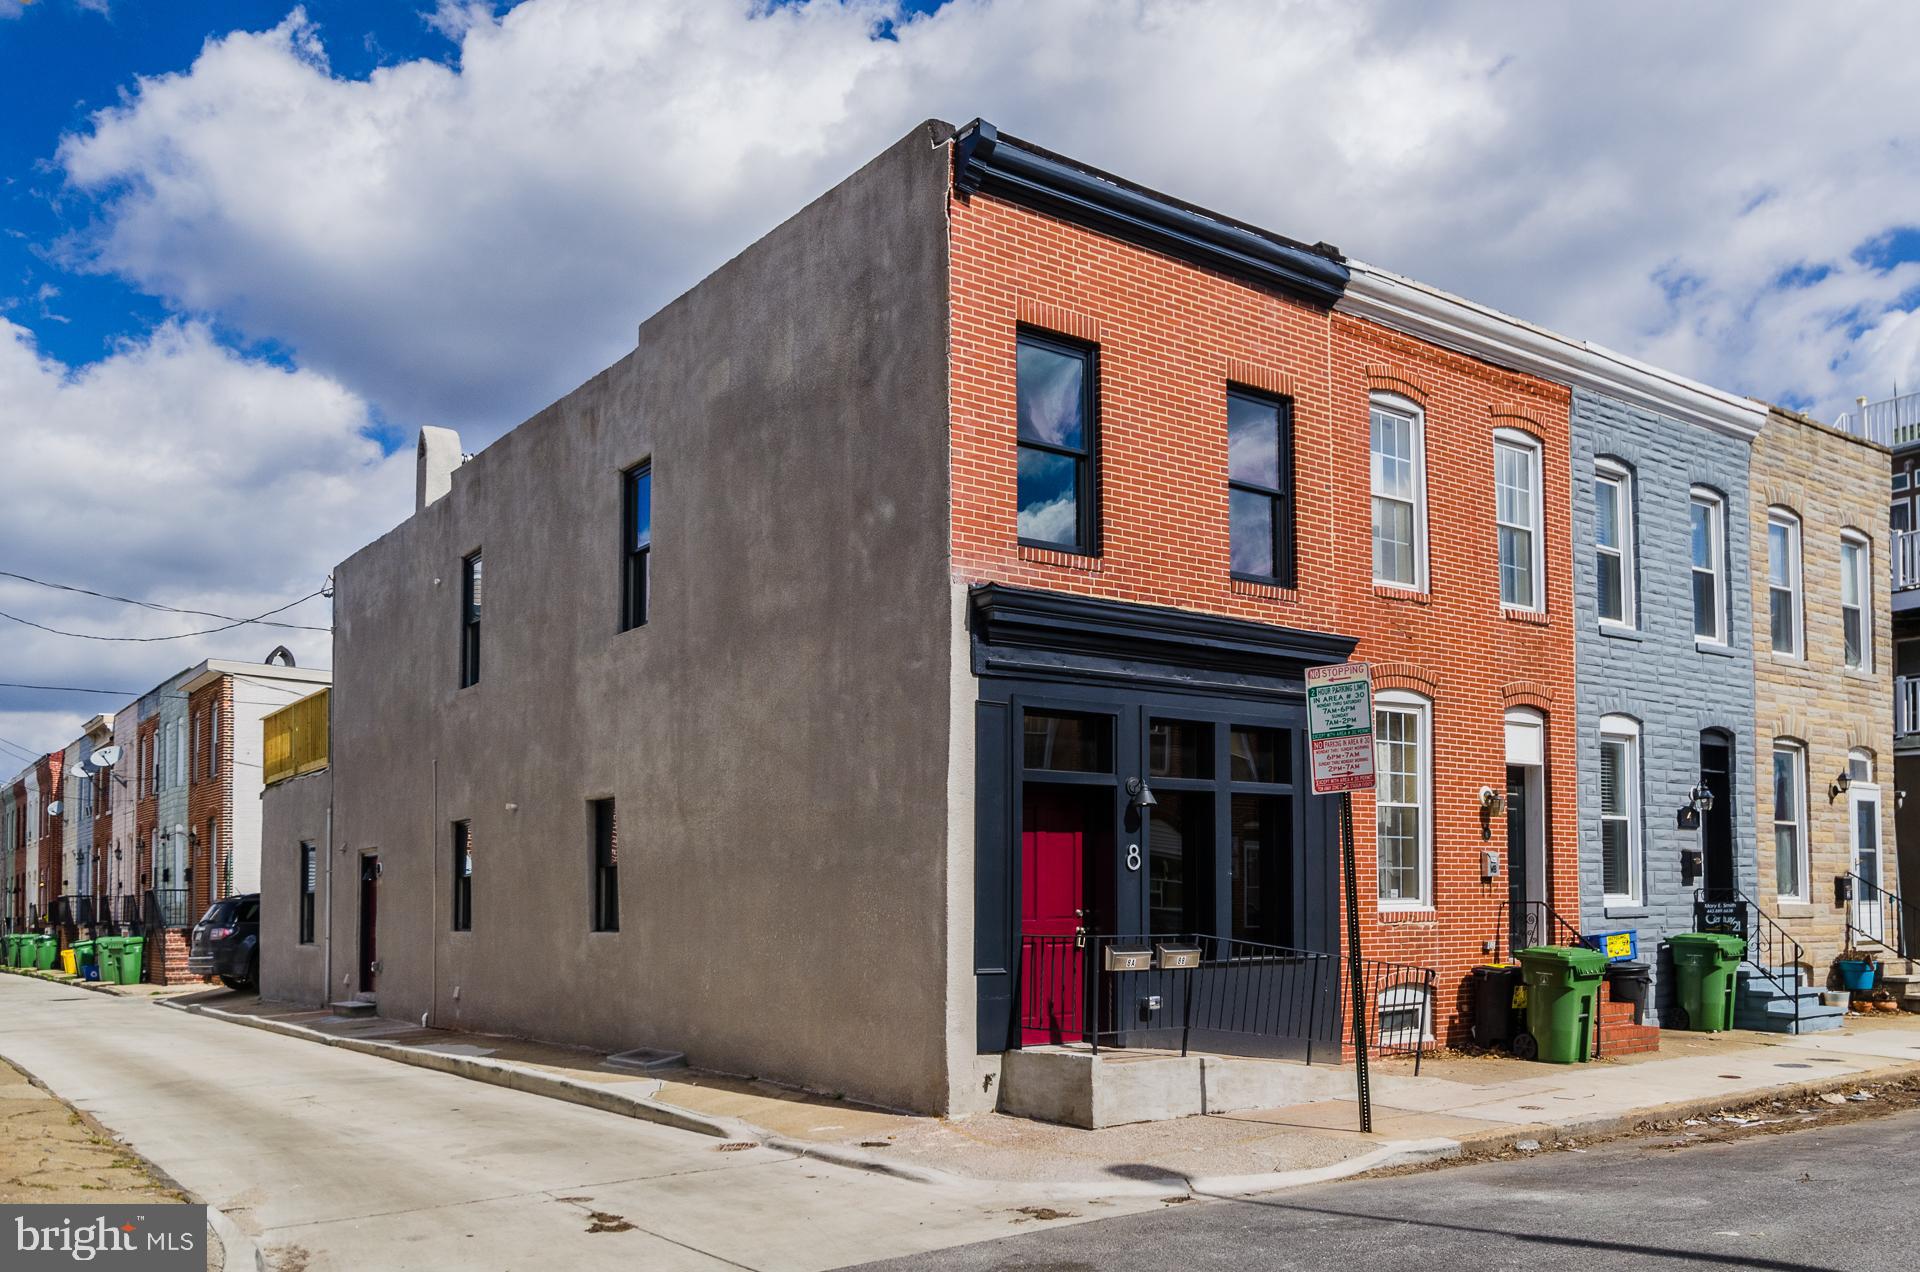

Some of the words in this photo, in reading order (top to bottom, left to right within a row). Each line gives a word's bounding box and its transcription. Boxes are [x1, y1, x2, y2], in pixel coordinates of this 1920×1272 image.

[1310, 669, 1319, 679] NO
[1322, 665, 1364, 678] STOPPING
[1318, 687, 1330, 696] HOUR
[1332, 684, 1352, 694] PARKING
[1354, 682, 1366, 690] LIMIT
[1322, 694, 1344, 702] AREA
[1325, 718, 1357, 726] 7AM-2PM
[1327, 752, 1360, 760] 6PM-7AM
[1328, 764, 1360, 772] 2PM-7AM
[1127, 844, 1141, 870] 8
[1732, 920, 1741, 931] 21
